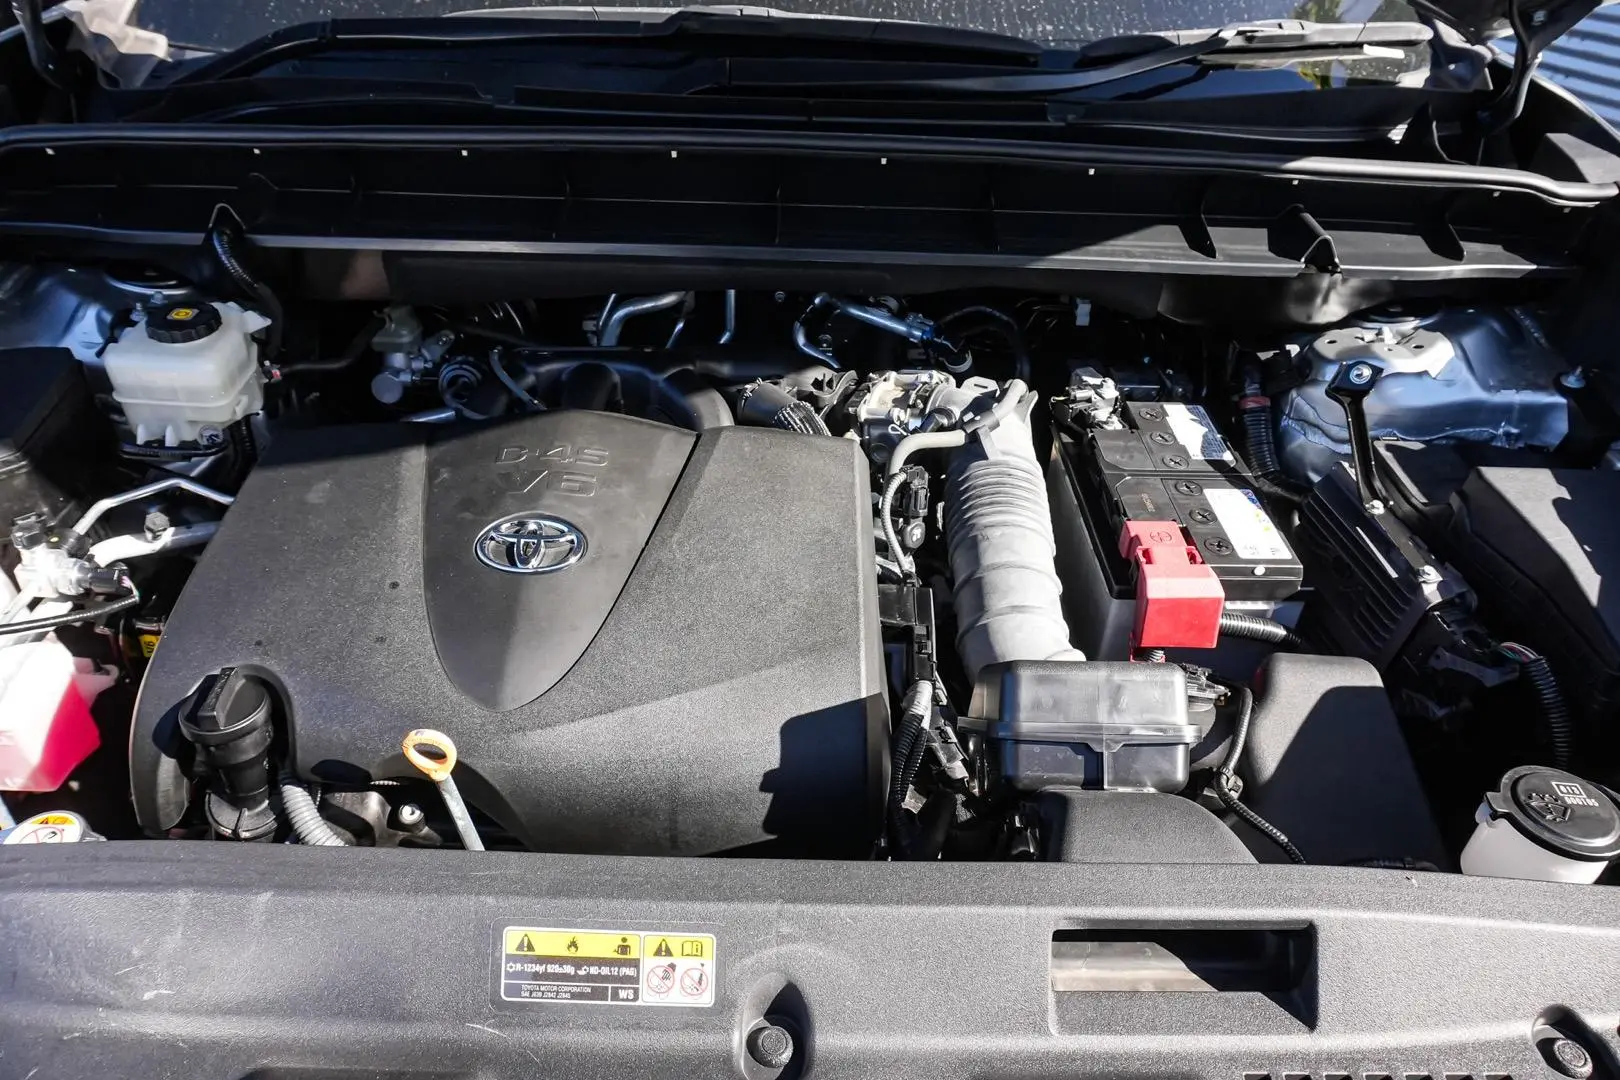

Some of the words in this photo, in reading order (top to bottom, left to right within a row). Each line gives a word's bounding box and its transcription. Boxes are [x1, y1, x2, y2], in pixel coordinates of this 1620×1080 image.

[497, 445, 609, 467] D-4S
[500, 470, 598, 497] V6
[618, 989, 634, 999] WS
